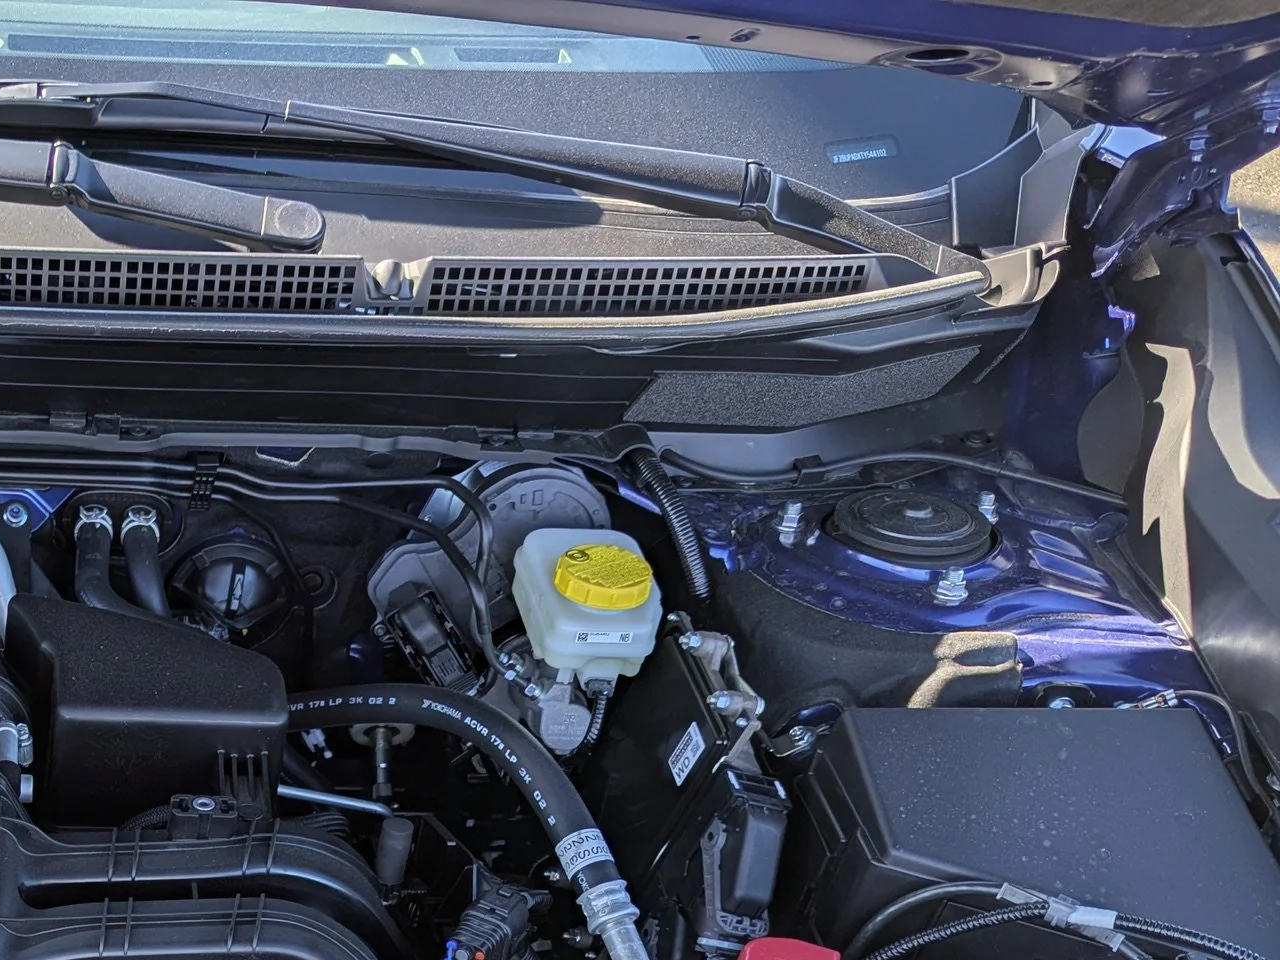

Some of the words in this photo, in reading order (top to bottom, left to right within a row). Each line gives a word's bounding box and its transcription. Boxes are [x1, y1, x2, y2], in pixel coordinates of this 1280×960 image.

[328, 697, 343, 706] LP
[388, 697, 397, 705] 2
[464, 716, 489, 738] ACVR
[504, 749, 519, 765] LP
